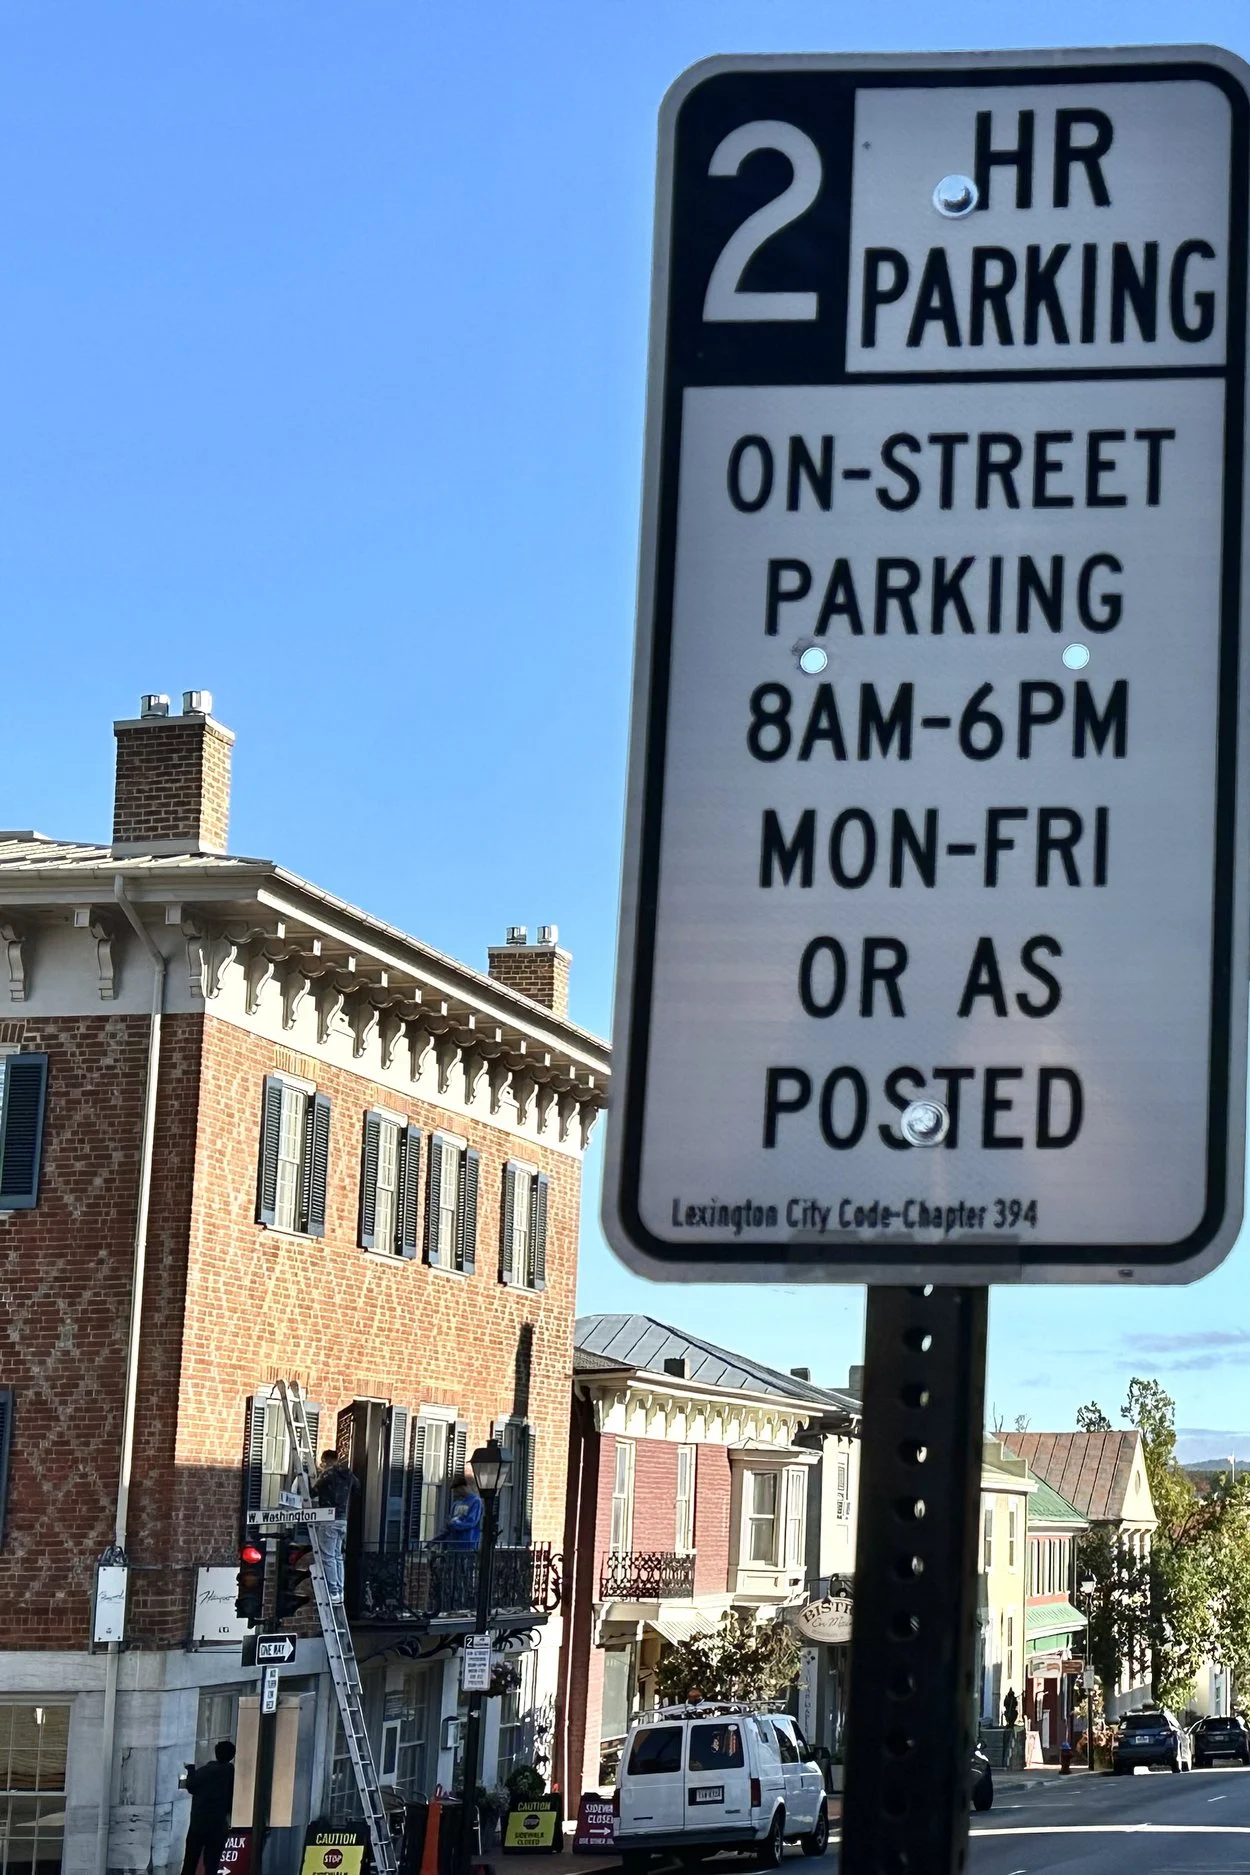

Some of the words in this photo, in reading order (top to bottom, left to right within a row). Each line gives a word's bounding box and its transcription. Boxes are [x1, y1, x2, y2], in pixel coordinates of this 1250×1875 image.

[974, 107, 1115, 210] HR
[702, 118, 824, 322] 2
[860, 239, 1217, 349] PARKING
[725, 428, 1176, 514] ON-STREET
[764, 552, 1125, 636] PARKING
[746, 679, 1130, 763] 8AM-6PM
[758, 805, 1109, 890] MON-FRI
[798, 935, 908, 1018] OR
[956, 933, 1063, 1018] AS
[761, 1065, 1085, 1151] POSTED
[671, 1196, 778, 1236] Lexington
[786, 1198, 831, 1234] City
[992, 1198, 1039, 1230] 394
[262, 1511, 317, 1522] Washington
[466, 1637, 473, 1648] 2
[315, 1833, 357, 1845] CAUTION
[517, 1801, 551, 1811] CAUTION
[323, 1854, 342, 1863] STOP
